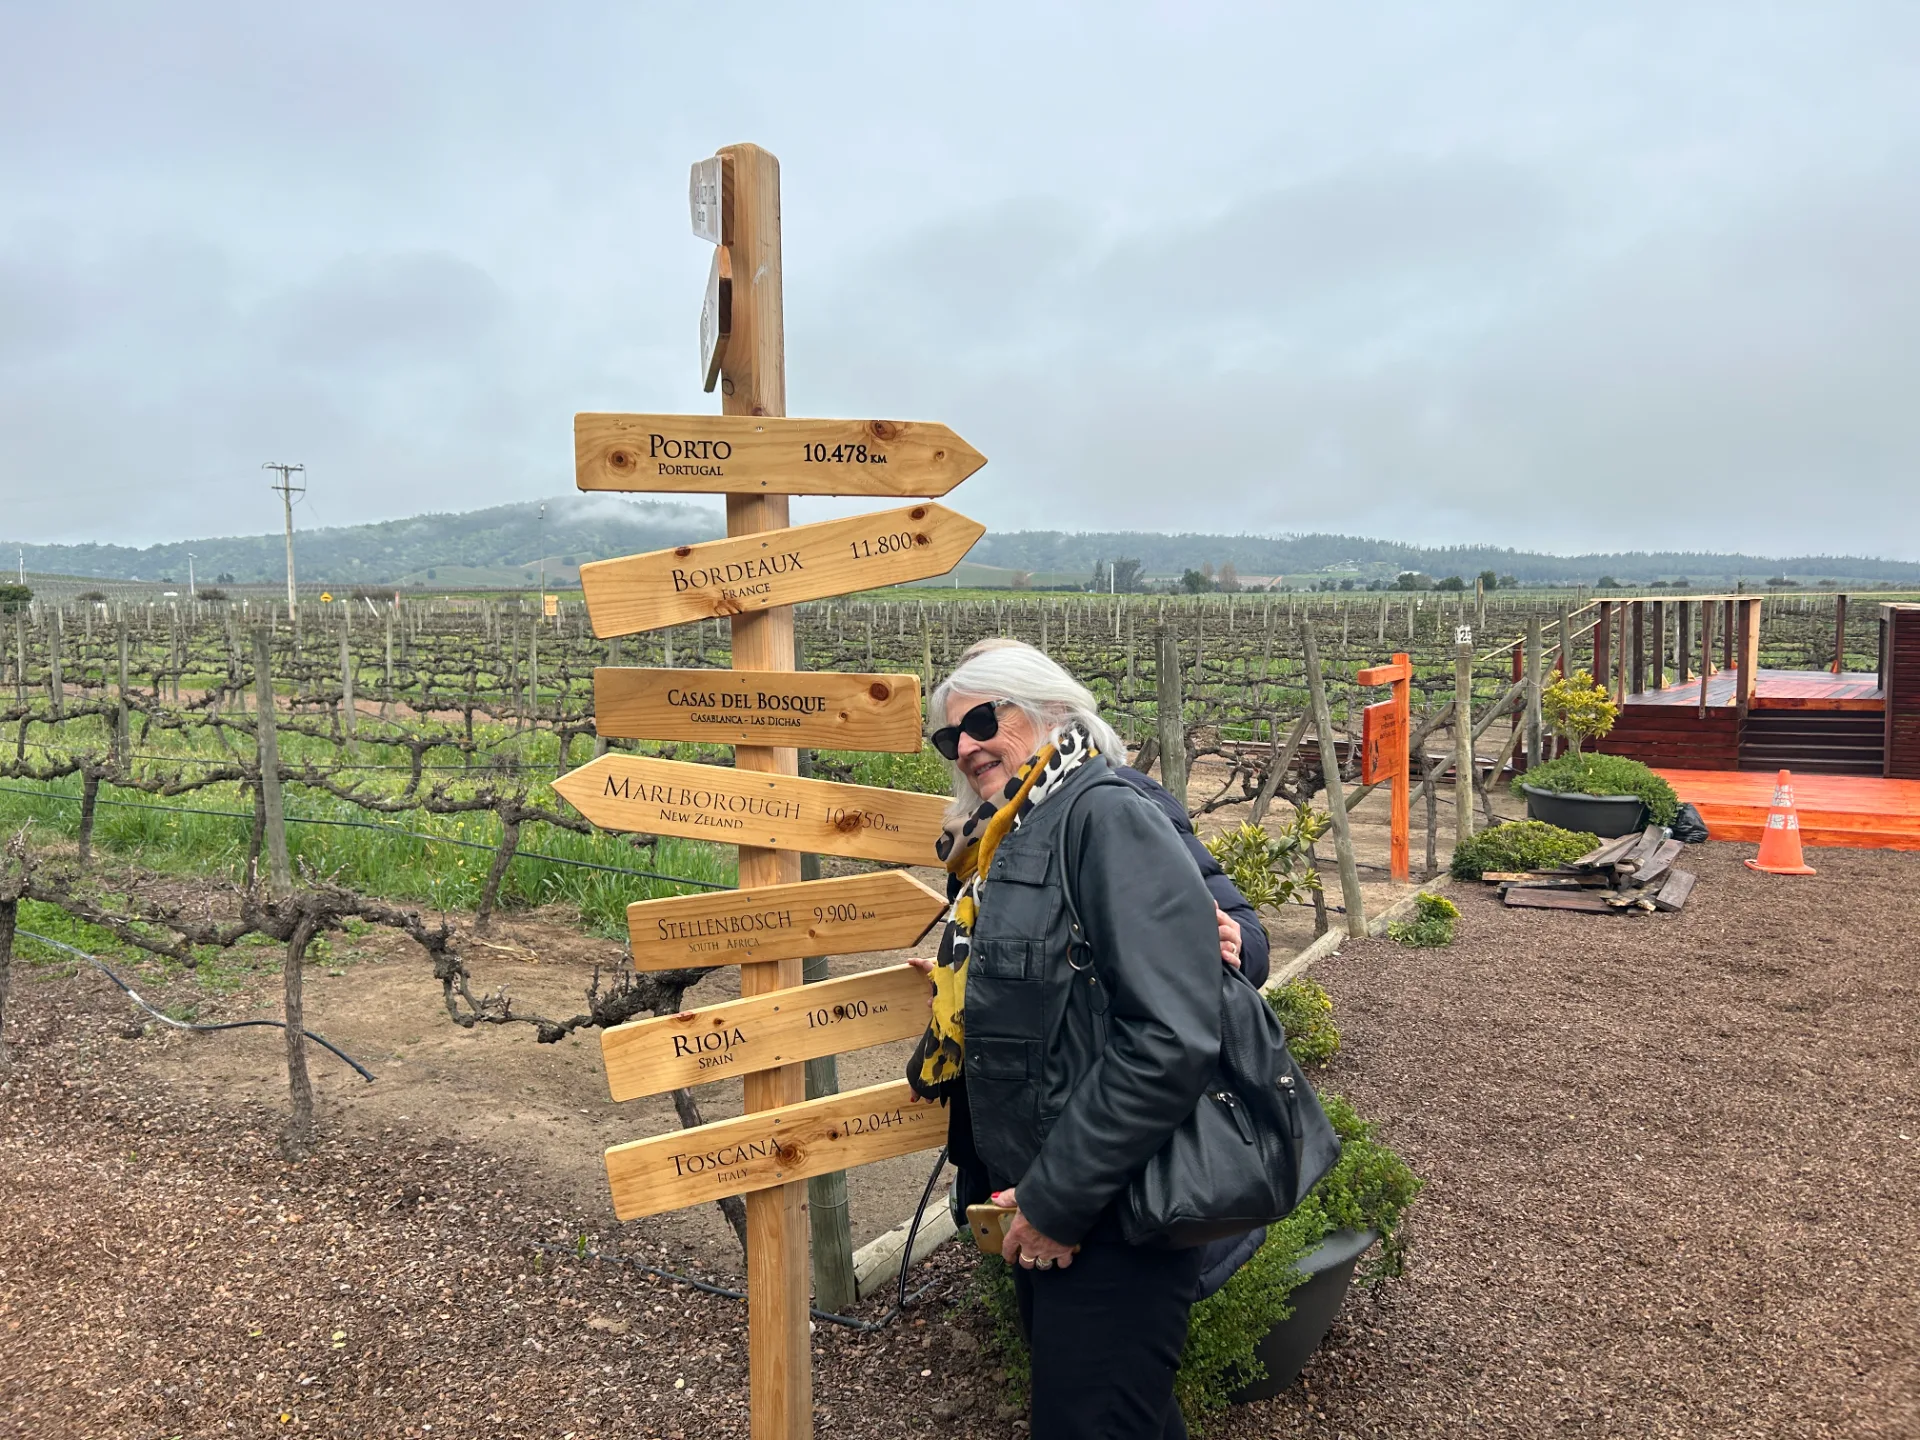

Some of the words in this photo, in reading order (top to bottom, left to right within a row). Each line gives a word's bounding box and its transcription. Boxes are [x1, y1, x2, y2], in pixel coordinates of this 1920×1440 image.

[648, 433, 731, 459] PORTO
[803, 443, 867, 464] 10.478
[870, 455, 887, 465] KM
[658, 463, 723, 476] PORTUGAL
[672, 552, 804, 592] BORDEAUX
[849, 532, 912, 559] 11.800
[722, 582, 771, 600] FRANCE
[667, 689, 716, 707] CASAS
[721, 693, 752, 709] DEL
[757, 694, 826, 714] BOSQUE
[691, 712, 743, 725] CASABLANCA
[750, 715, 765, 725] LAS
[768, 716, 801, 727] DICHAS
[603, 774, 800, 820] MARLBOROUGH
[659, 809, 689, 823] NEW
[694, 813, 743, 829] ZELAND
[658, 910, 792, 940] STELLENBOSCH
[813, 903, 857, 924] 9.900
[688, 942, 719, 953] SOUTH
[726, 937, 760, 949] AFRICA
[671, 1027, 748, 1058] RIOJA
[806, 1000, 868, 1029] 10.900
[872, 1004, 889, 1014] KM
[698, 1053, 734, 1069] SPAIN
[667, 1137, 783, 1177] TOSCANA
[842, 1108, 904, 1137] 12.044
[716, 1168, 748, 1183] ITALY
